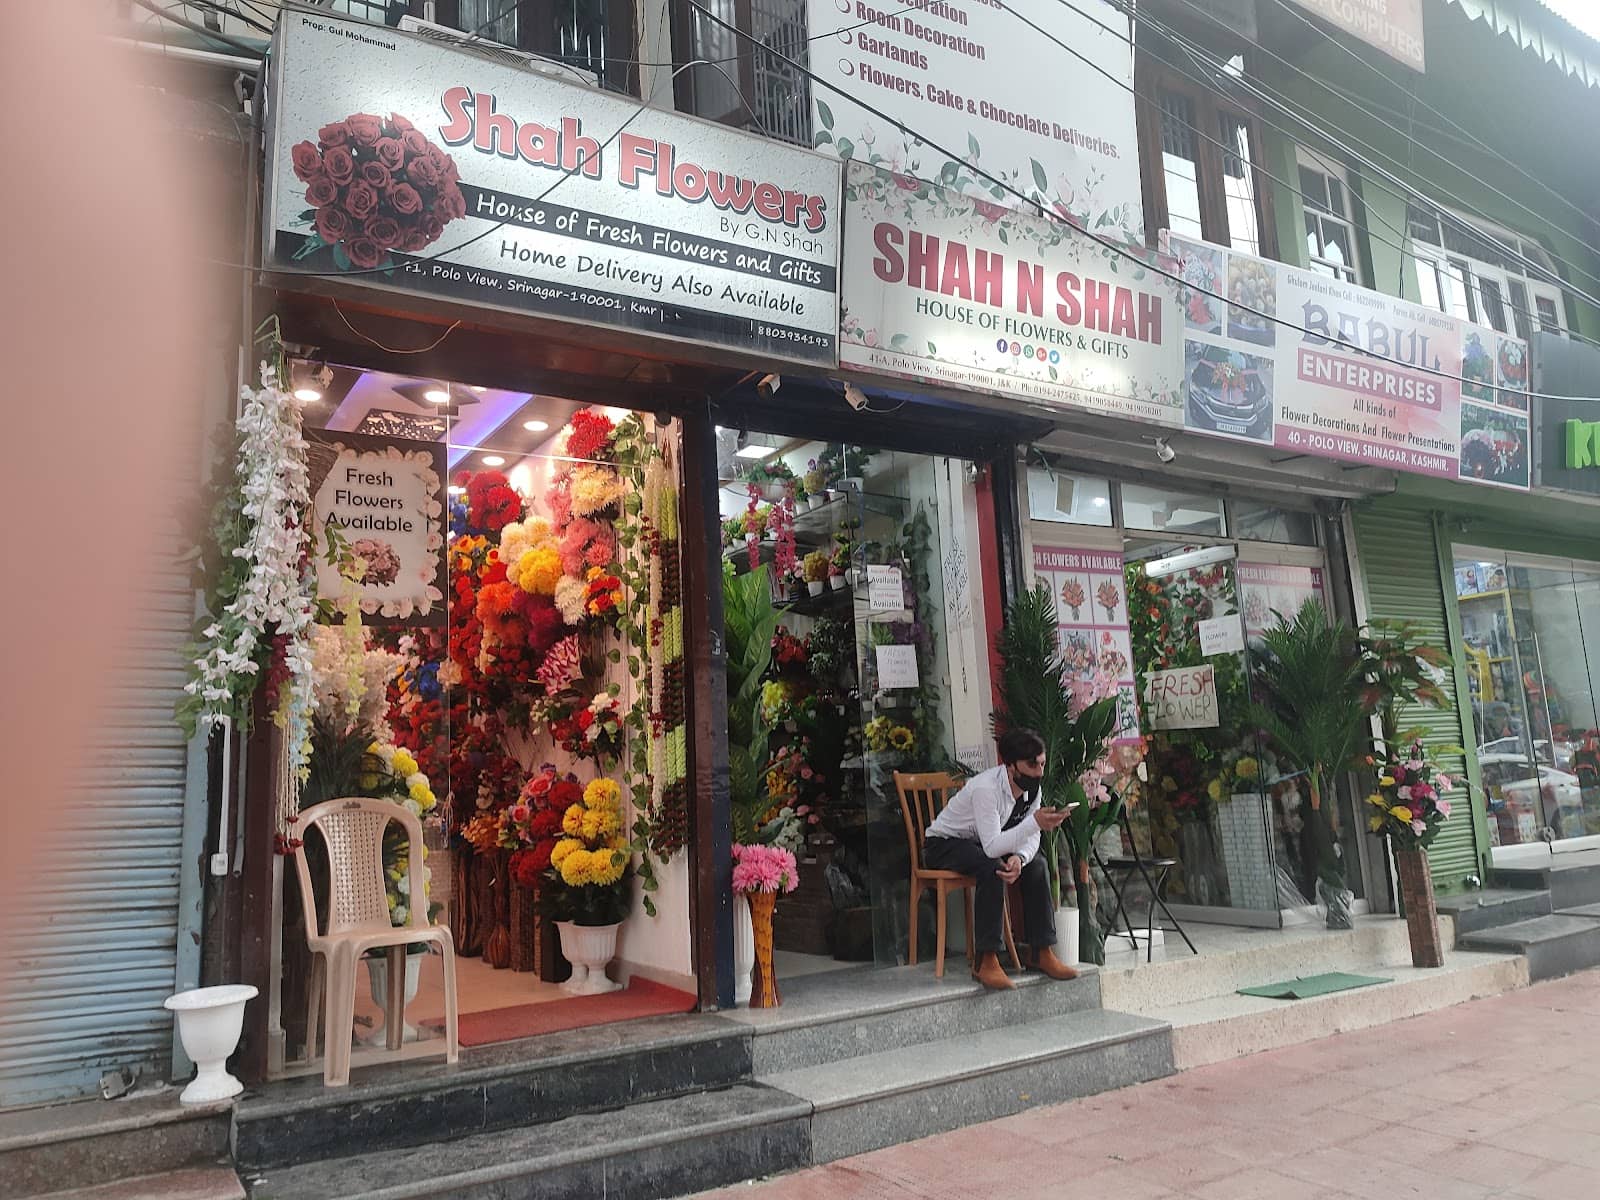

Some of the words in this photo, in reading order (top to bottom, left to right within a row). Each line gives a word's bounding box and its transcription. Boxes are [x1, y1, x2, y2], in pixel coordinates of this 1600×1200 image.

[302, 18, 326, 32] Prop:
[328, 25, 343, 36] Gul
[345, 30, 396, 51] Mohammad
[855, 1, 901, 33] Room
[904, 17, 986, 60] Decoration
[857, 31, 929, 71] Garlands
[858, 63, 925, 101] Flowers,
[926, 83, 964, 111] Cake
[966, 99, 978, 116] &
[979, 100, 1051, 138] Chocolate
[1052, 122, 1121, 160] Deliveries.
[438, 85, 602, 180] Shah
[617, 130, 828, 234] Flowers
[476, 194, 547, 226] House
[555, 210, 579, 233] of
[586, 218, 644, 247] Fresh
[651, 232, 729, 265] Flowers
[735, 251, 772, 274] and
[779, 261, 823, 285] Gifts
[719, 216, 740, 238] By
[744, 224, 778, 245] G.N
[782, 228, 824, 255] Shah
[432, 265, 461, 281] Polo
[466, 272, 503, 290] View,
[507, 279, 627, 312] Srinagar-190001,
[630, 301, 657, 316] Kmr
[499, 239, 567, 269] Home
[576, 254, 663, 293] Delivery
[671, 275, 713, 298] Also
[720, 285, 805, 316] Available
[873, 221, 1004, 309] SHAH
[1016, 259, 1044, 318] N
[1056, 271, 1162, 346] SHAH
[757, 326, 829, 347] 8803934193
[916, 296, 974, 325] HOUSE
[978, 310, 1001, 331] OF
[1004, 317, 1073, 347] FLOWERS
[1077, 334, 1087, 350] &
[1091, 337, 1129, 359] GIFTS
[1301, 298, 1441, 372] BABUL
[892, 358, 910, 369] Polo
[1302, 353, 1436, 404] ENTERPRISES
[1352, 399, 1364, 412] All
[1366, 402, 1386, 417] kinds
[1388, 406, 1397, 418] of
[1281, 406, 1310, 424] Flower
[1312, 412, 1360, 434] Decorations
[1362, 423, 1377, 437] And
[1381, 426, 1405, 442] Flower
[1407, 432, 1456, 453] Presentations
[1288, 431, 1300, 444] 40
[1308, 434, 1335, 450] POLO
[1337, 441, 1361, 457] VIEW,
[1362, 444, 1410, 465] SRINAGAR,
[1411, 454, 1449, 472] KASHMIR.
[345, 468, 394, 487] Fresh
[335, 489, 404, 510] Flowers
[325, 511, 414, 533] Available
[871, 575, 899, 585] Available
[1042, 553, 1080, 568] FLOWERS
[1081, 554, 1122, 570] AVAILABLE
[873, 600, 901, 608] Available
[1151, 668, 1214, 701] FRESH
